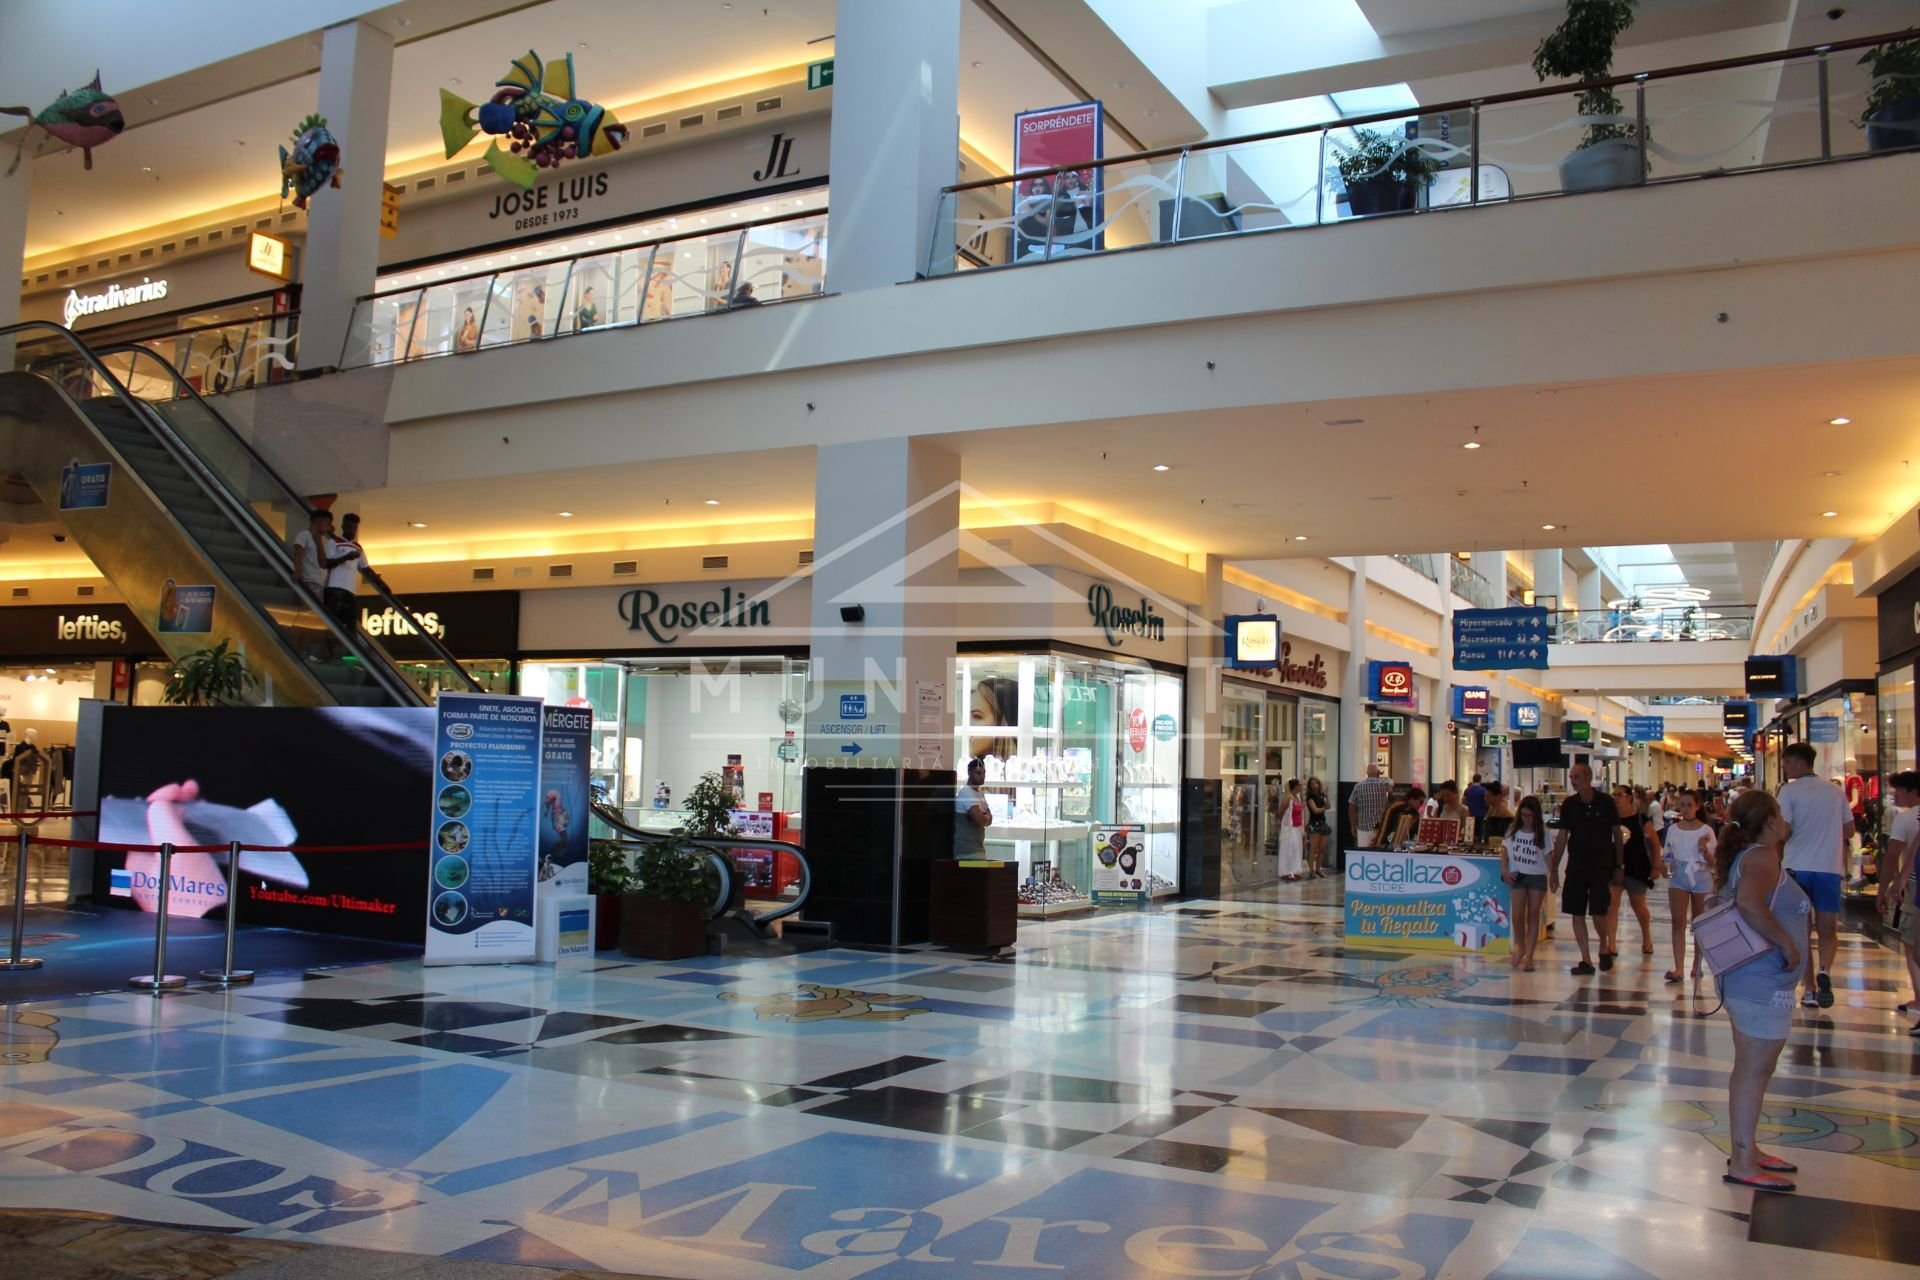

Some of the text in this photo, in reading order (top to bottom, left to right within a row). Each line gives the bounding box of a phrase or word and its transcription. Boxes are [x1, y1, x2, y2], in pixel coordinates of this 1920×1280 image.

[1023, 112, 1093, 134] SORPRÉNDETE
[753, 131, 802, 182] JL
[489, 171, 609, 220] JOSE LUIS
[515, 207, 579, 231] DESDE 1973
[617, 585, 771, 645] Roselin
[1087, 583, 1165, 647] Roselin
[1459, 617, 1513, 628] Hipermercado
[1459, 634, 1506, 644] Ascensores
[1459, 650, 1486, 660] Aseos
[443, 711, 469, 720] FORMA
[490, 713, 499, 721] DE
[820, 724, 863, 735] ASCENSOR
[870, 724, 887, 735] LIFT
[544, 751, 573, 760] GRATIS
[167, 874, 226, 897] Mares
[1369, 882, 1406, 893] STORE
[249, 885, 397, 915] Youtube.com/Ultimaker
[1350, 899, 1447, 918] Personaliza
[1360, 916, 1439, 938] tu Regalo
